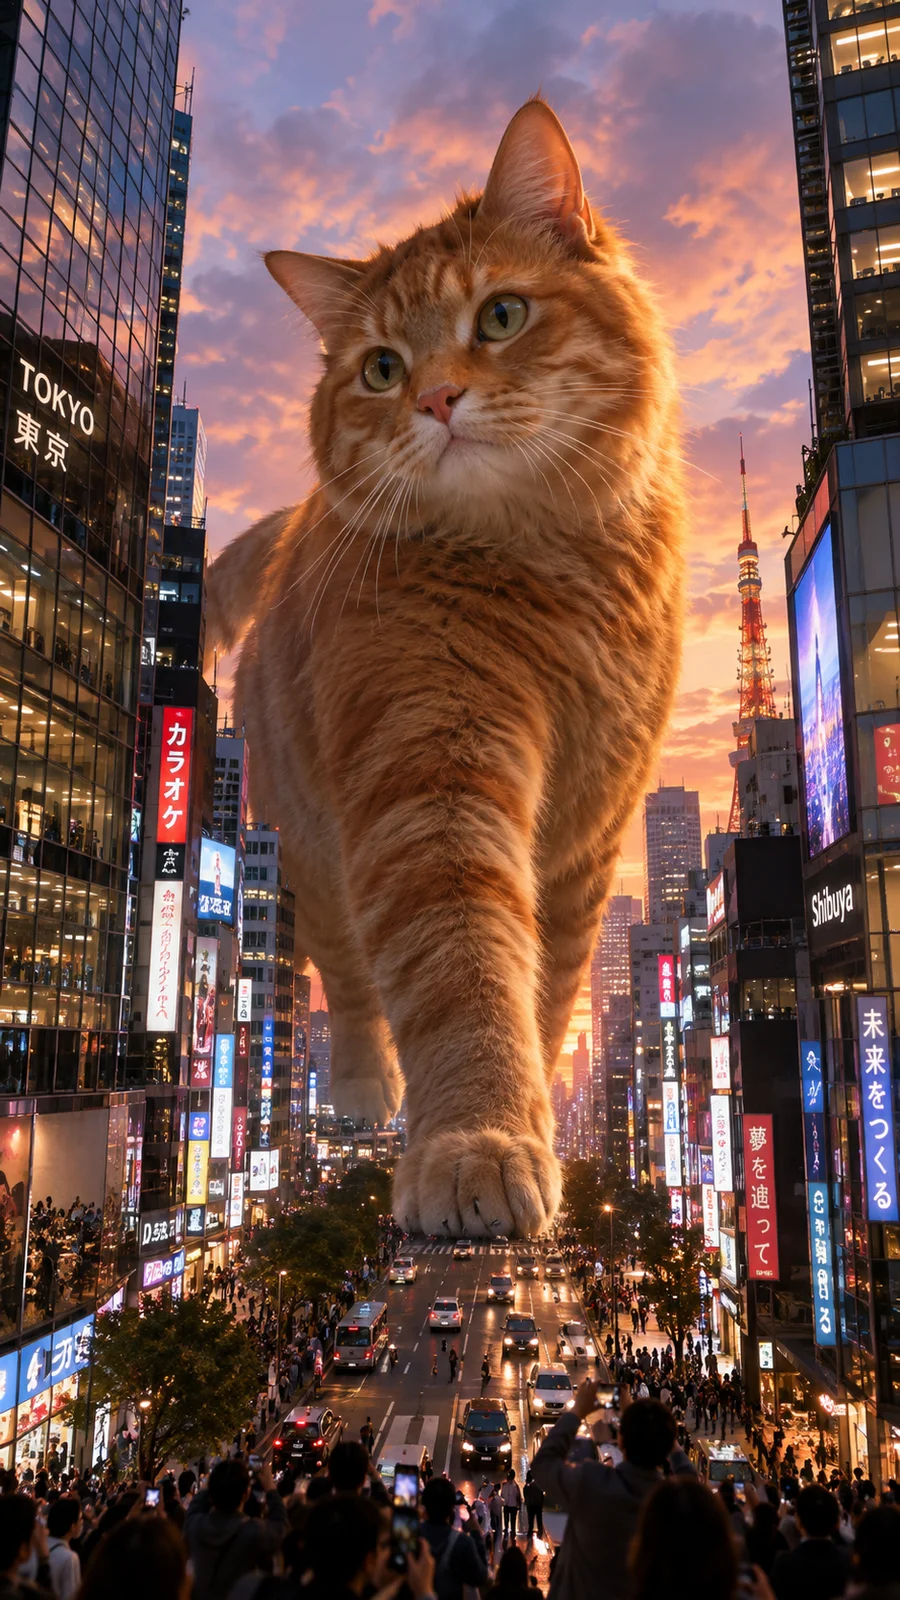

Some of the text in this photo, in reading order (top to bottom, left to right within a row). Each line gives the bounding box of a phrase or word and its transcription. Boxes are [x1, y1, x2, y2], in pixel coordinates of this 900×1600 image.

[20, 358, 94, 436] TOKYO
[14, 409, 69, 473] 東京
[162, 723, 187, 829] カラオケ
[812, 884, 853, 928] Shibuya
[863, 1008, 892, 1210] 未来をつくる
